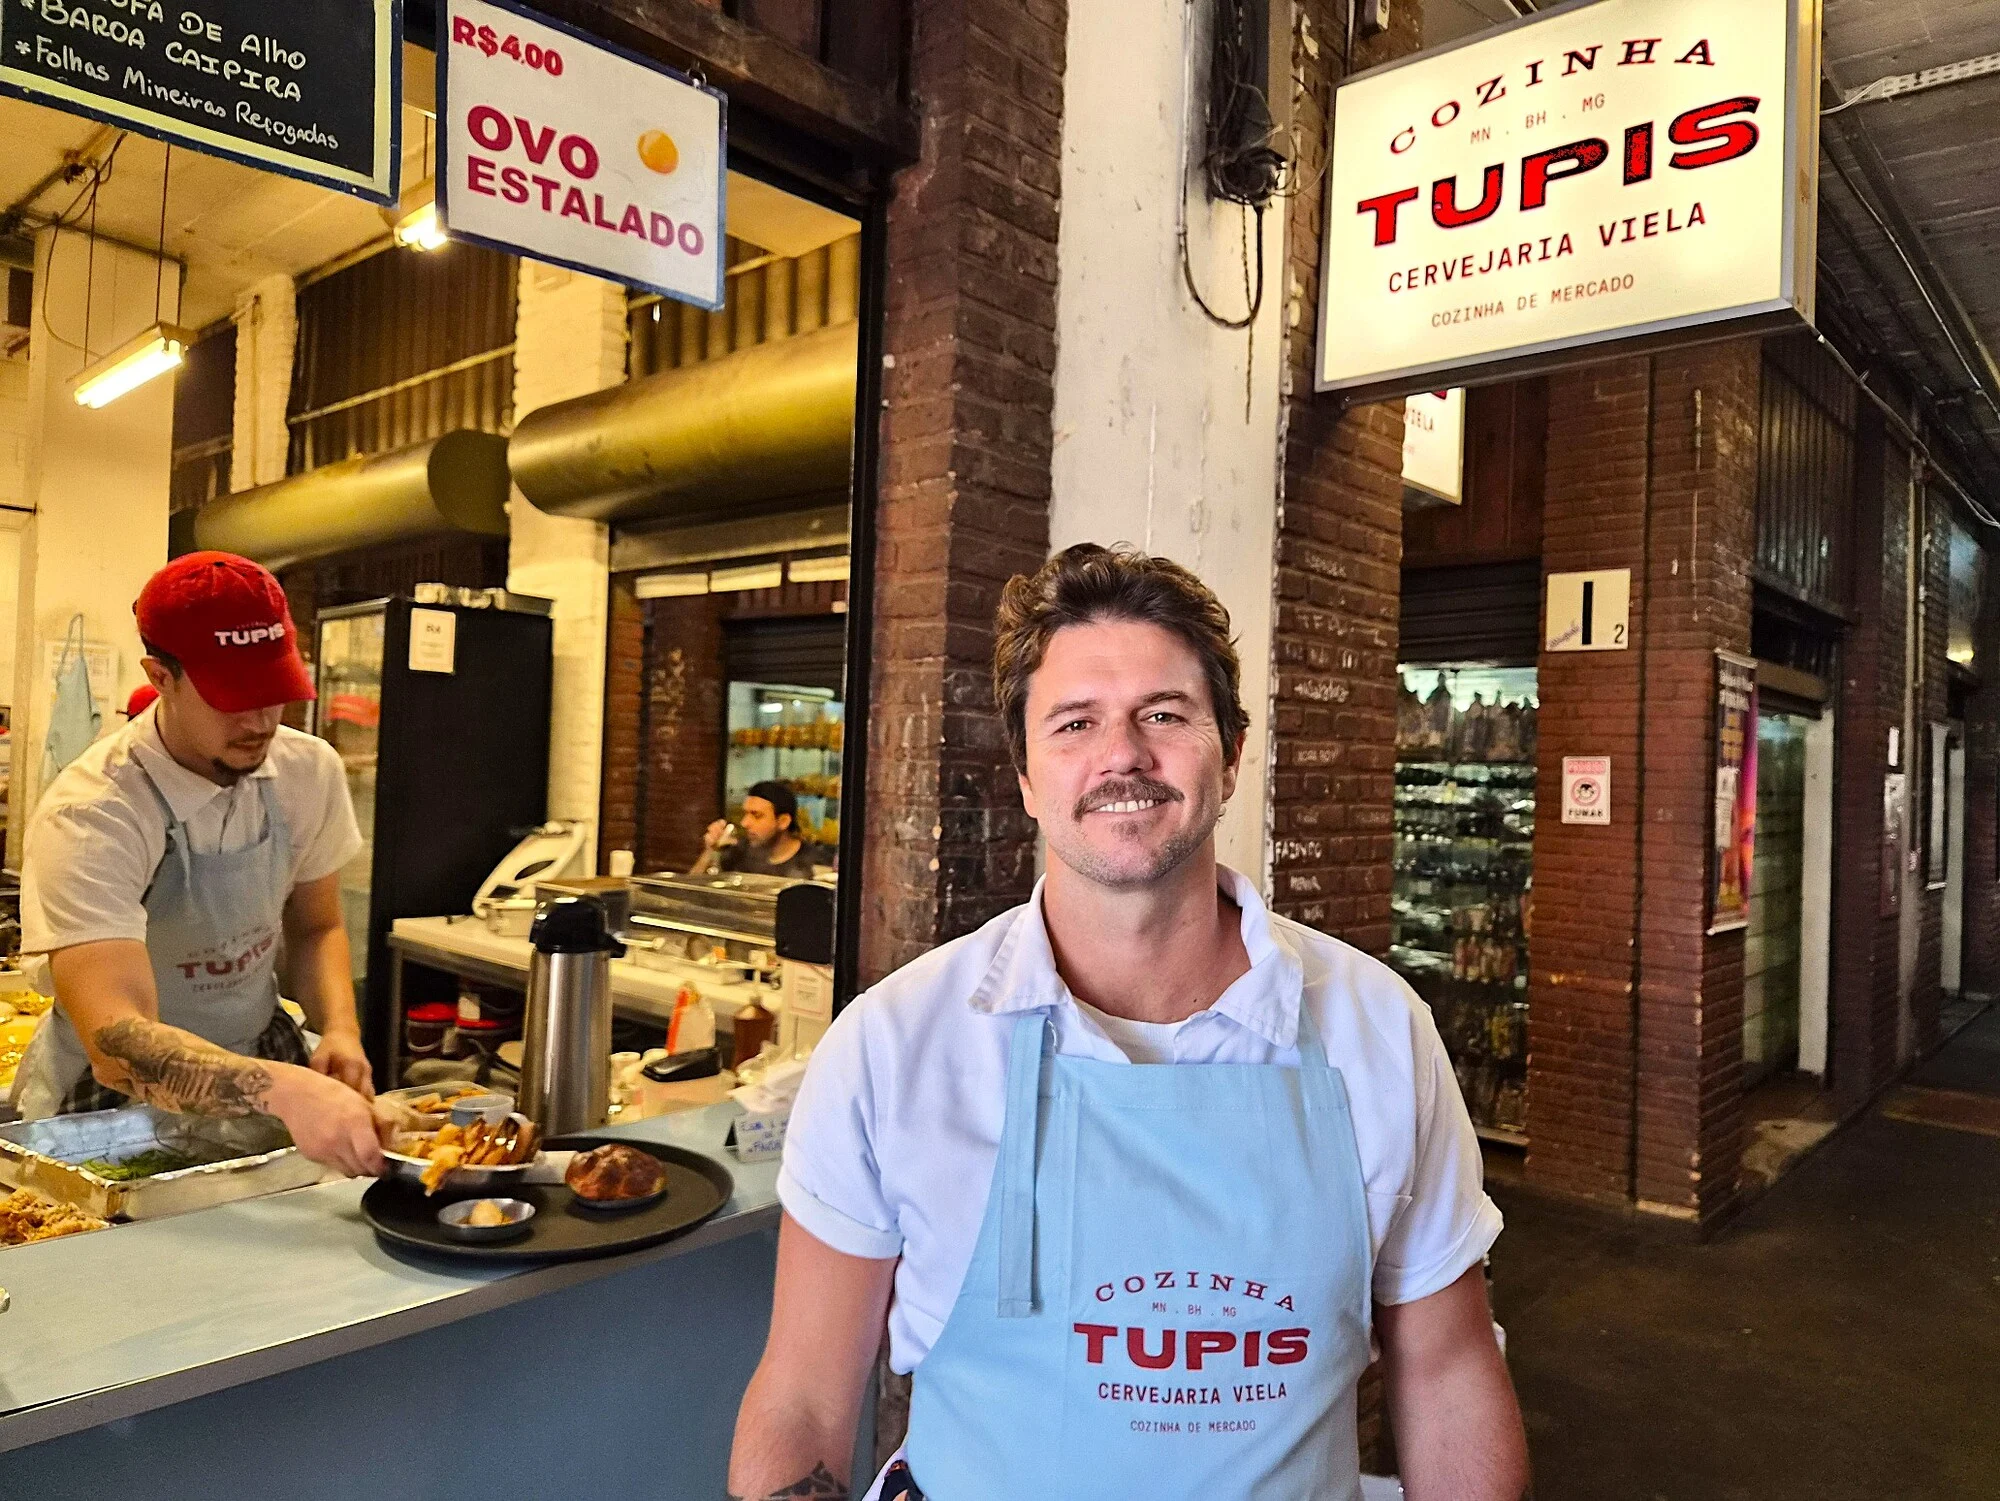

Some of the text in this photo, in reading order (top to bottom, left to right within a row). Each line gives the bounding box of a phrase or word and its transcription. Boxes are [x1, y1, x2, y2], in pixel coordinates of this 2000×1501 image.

[41, 0, 301, 102] BAROA CAIPIRA
[180, 12, 223, 43] DE
[241, 34, 306, 70] Alho
[36, 35, 110, 82] Folhas
[122, 66, 226, 118] Mineiras
[1390, 38, 1715, 154] COZINHA
[467, 105, 599, 180] OVO
[1471, 93, 1605, 145] MN BH MG
[1357, 96, 1761, 248] TUPIS
[468, 155, 705, 255] ESTALADO
[1389, 202, 1706, 293] CERVEJARIA VIELA
[1431, 274, 1635, 328] COZINHA DE MERCADO
[1614, 623, 1624, 644] 2
[1095, 1271, 1295, 1312] COZINHA
[1152, 1301, 1237, 1317] MN BH MG
[1073, 1322, 1311, 1371] TUPIS
[1098, 1382, 1287, 1405] CERVEJARIA VIELA
[1130, 1419, 1257, 1433] COZINHA DE MERCADO
